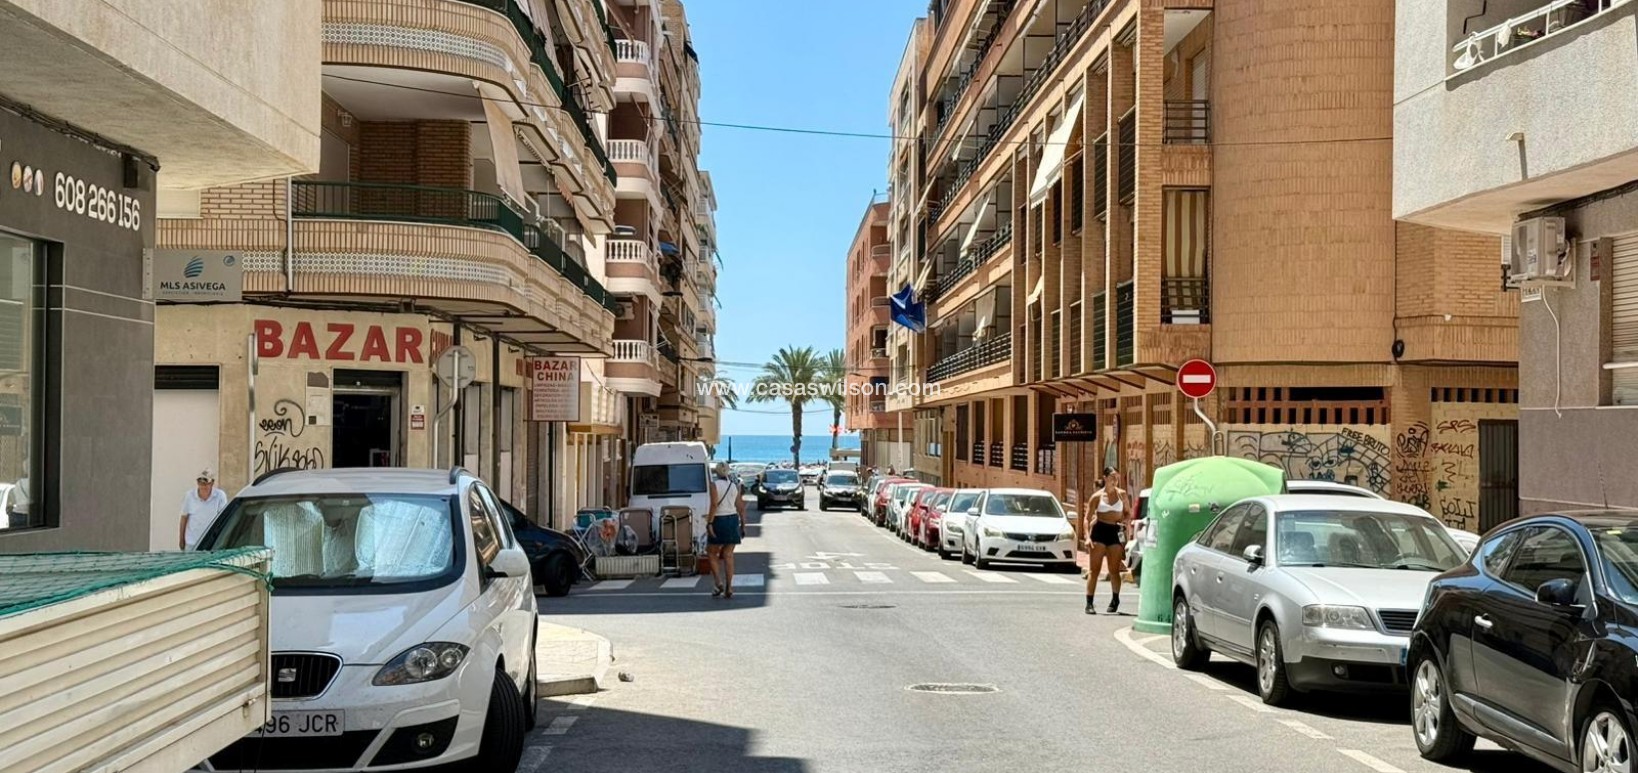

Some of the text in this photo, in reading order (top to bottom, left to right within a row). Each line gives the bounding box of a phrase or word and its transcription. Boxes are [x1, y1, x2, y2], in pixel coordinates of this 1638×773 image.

[55, 172, 141, 231] 608 266 156
[160, 281, 226, 291] MLS ASIVEGA
[254, 319, 424, 364] BAZAR
[534, 360, 578, 370] BAZAR
[537, 372, 574, 381] CHINA
[1341, 427, 1363, 442] FREE
[298, 714, 337, 734] JCR
